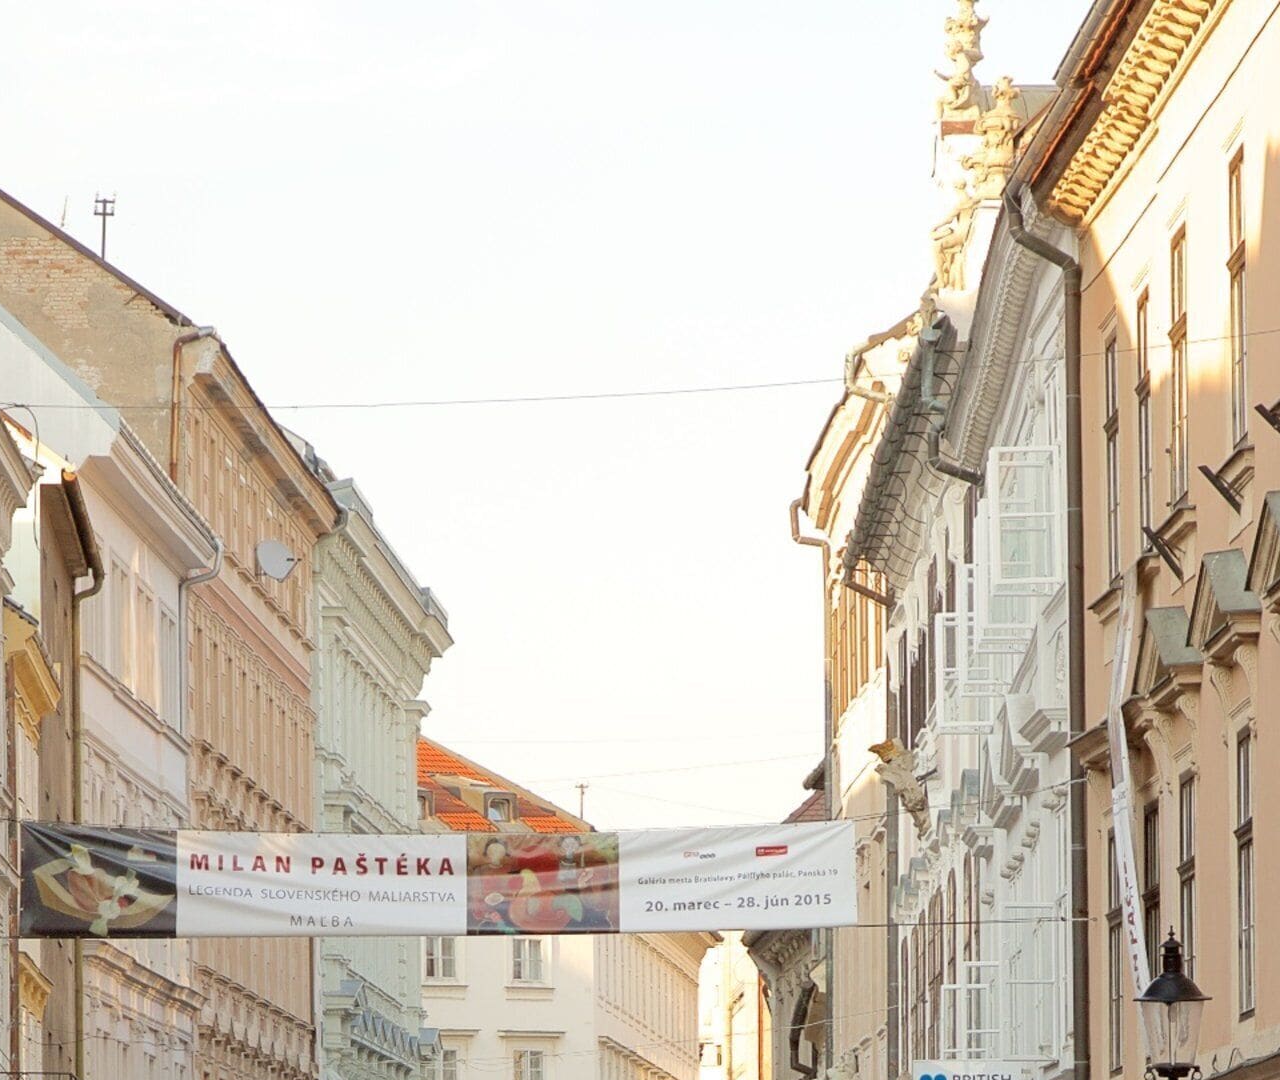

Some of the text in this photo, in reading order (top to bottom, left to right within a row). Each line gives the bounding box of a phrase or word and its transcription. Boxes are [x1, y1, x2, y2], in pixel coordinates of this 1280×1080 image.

[189, 853, 455, 877] MILAN PAŠTÉKA
[638, 876, 666, 885] Galéria
[668, 876, 693, 884] mesta
[797, 869, 827, 878] Panská
[828, 868, 839, 877] 19
[188, 884, 456, 903] LEGENDA SLOVENSKÉHO MALIARSTVA
[645, 900, 669, 912] 20.
[672, 900, 720, 912] marec
[737, 896, 761, 909] 28.
[764, 894, 790, 911] jún
[794, 893, 832, 907] 2015
